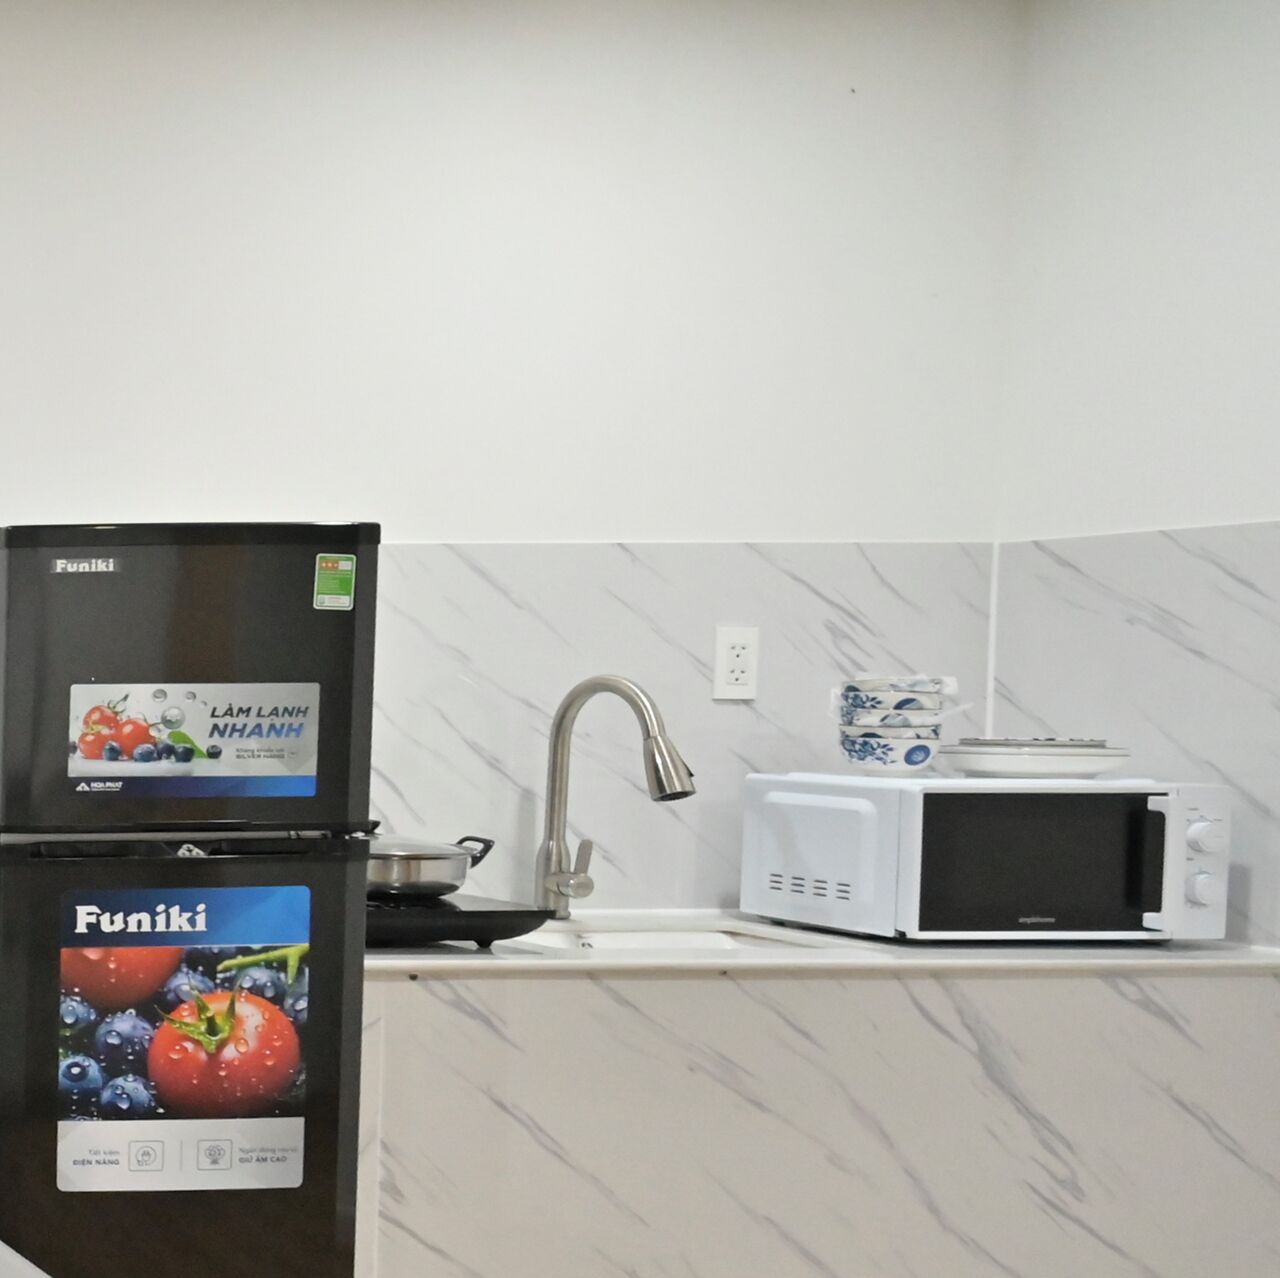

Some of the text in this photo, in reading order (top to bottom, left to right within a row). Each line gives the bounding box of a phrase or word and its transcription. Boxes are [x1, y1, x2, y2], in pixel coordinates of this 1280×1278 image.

[55, 558, 114, 573] Funiki
[210, 703, 252, 718] LÀM
[208, 722, 304, 738] NHANH
[74, 903, 207, 933] Funiki
